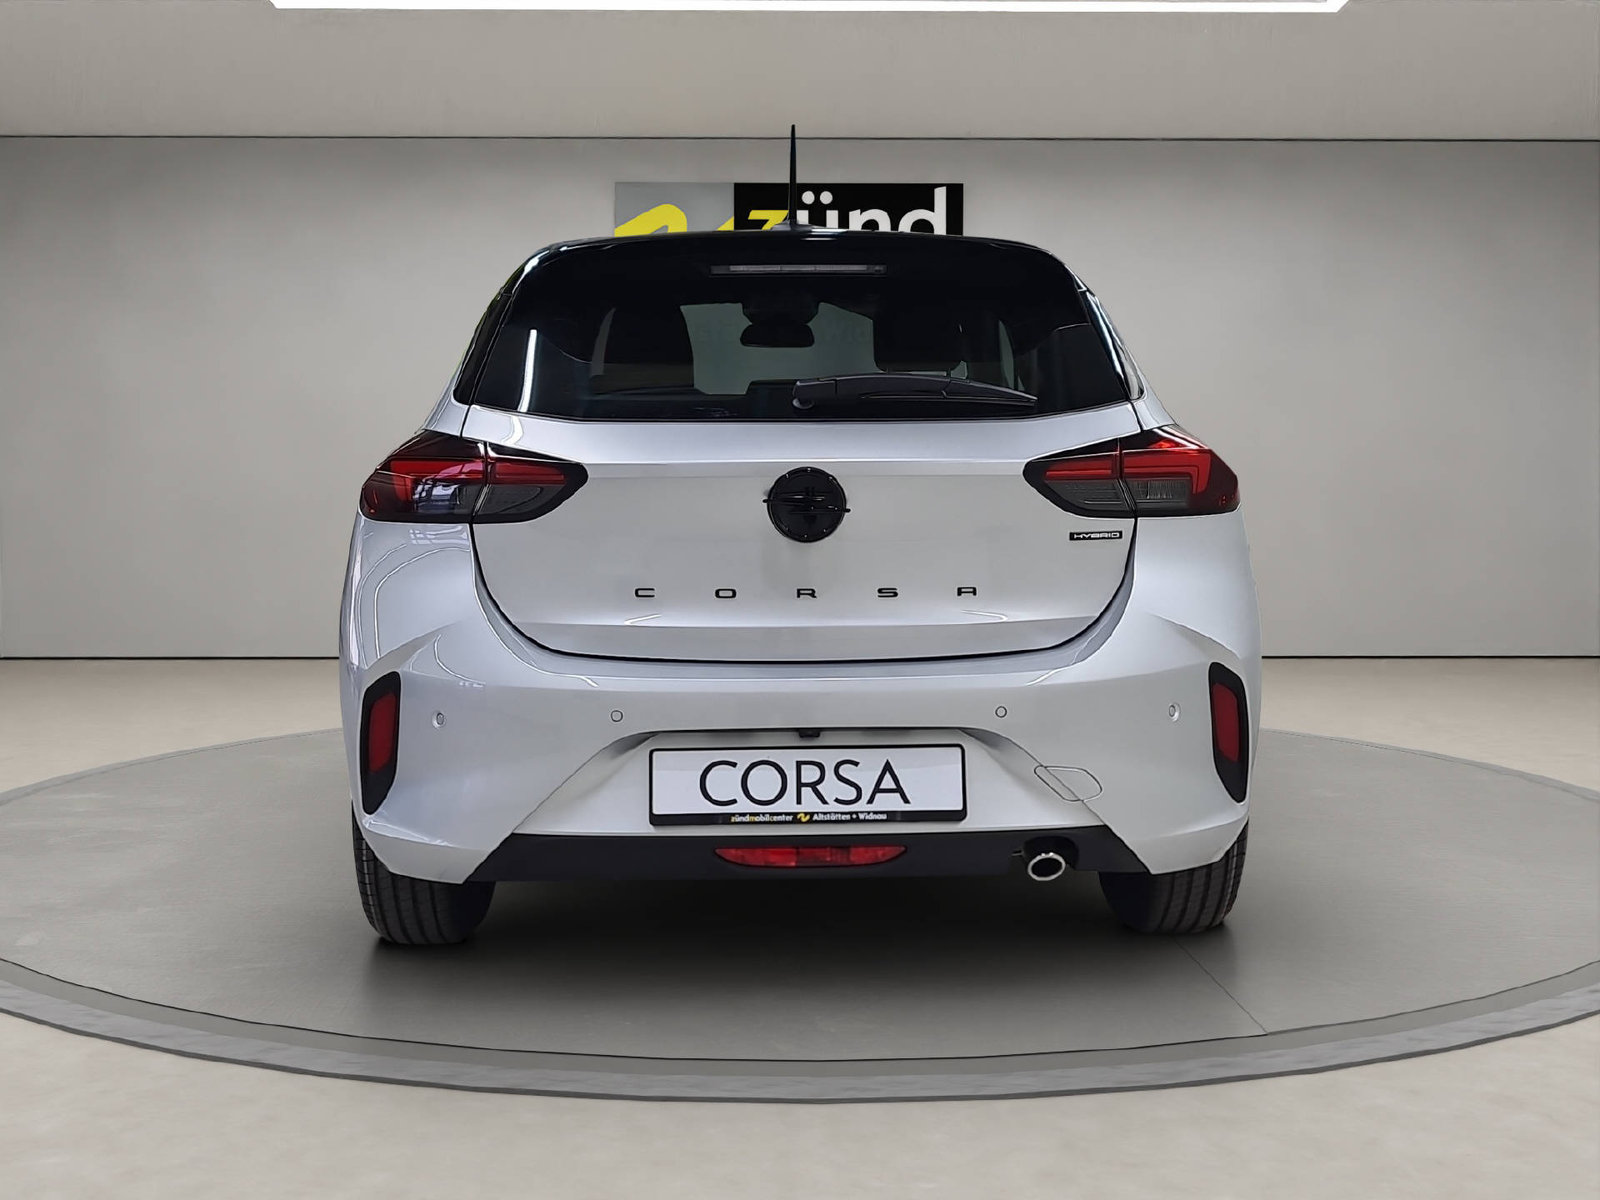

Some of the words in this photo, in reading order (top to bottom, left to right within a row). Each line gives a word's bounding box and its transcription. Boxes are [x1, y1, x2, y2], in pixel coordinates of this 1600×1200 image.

[1072, 531, 1121, 540] HYBRID
[634, 586, 978, 600] CORSA
[699, 758, 912, 807] CORSA
[858, 811, 888, 820] Widnau
